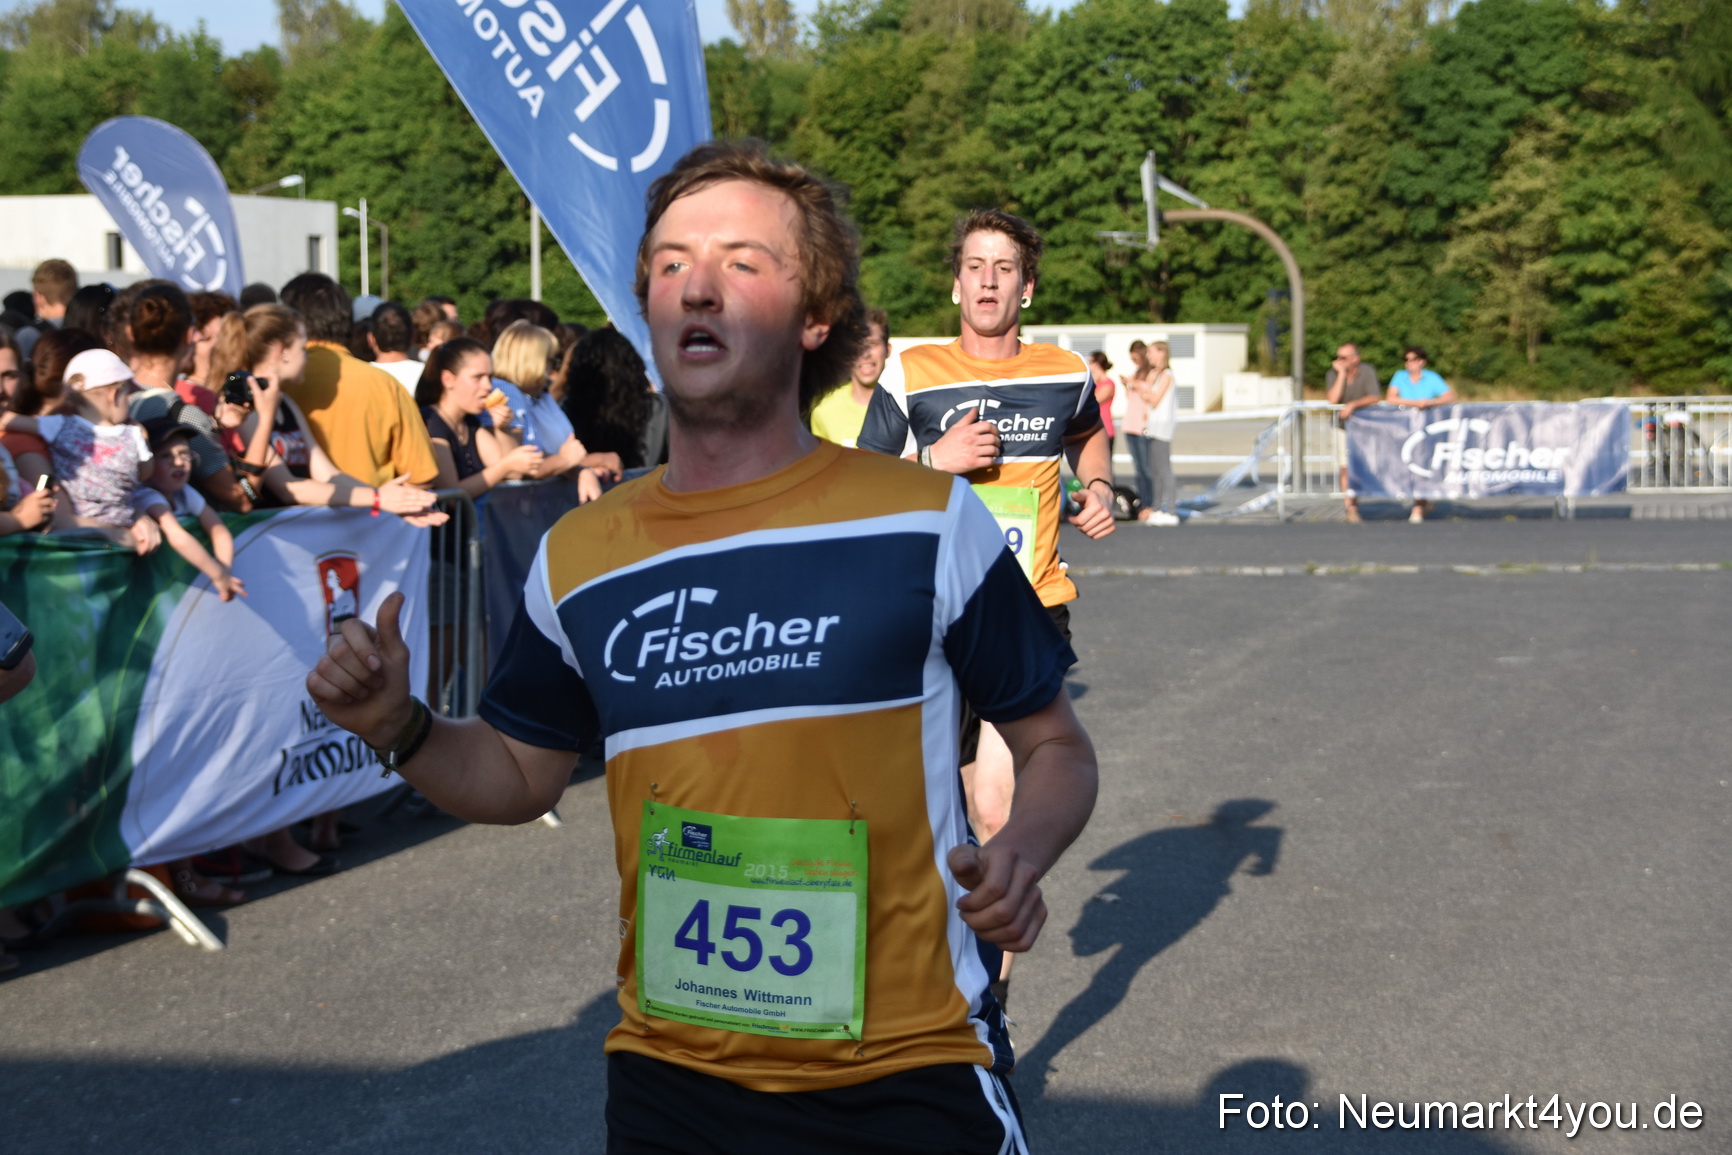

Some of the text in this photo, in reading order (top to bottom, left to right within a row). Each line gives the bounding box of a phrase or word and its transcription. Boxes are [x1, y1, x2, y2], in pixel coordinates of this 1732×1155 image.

[1431, 441, 1571, 470] Fischer
[1444, 470, 1560, 484] AUTOMOBILE
[637, 612, 841, 668] Fischer
[654, 651, 822, 690] AUTOMOBILE
[667, 842, 743, 868] firmenlauf
[743, 863, 789, 879] 2015
[674, 899, 813, 977] 453
[675, 978, 812, 1006] Johannes Wittmann
[696, 1000, 786, 1018] Fischer Automobile GmbH
